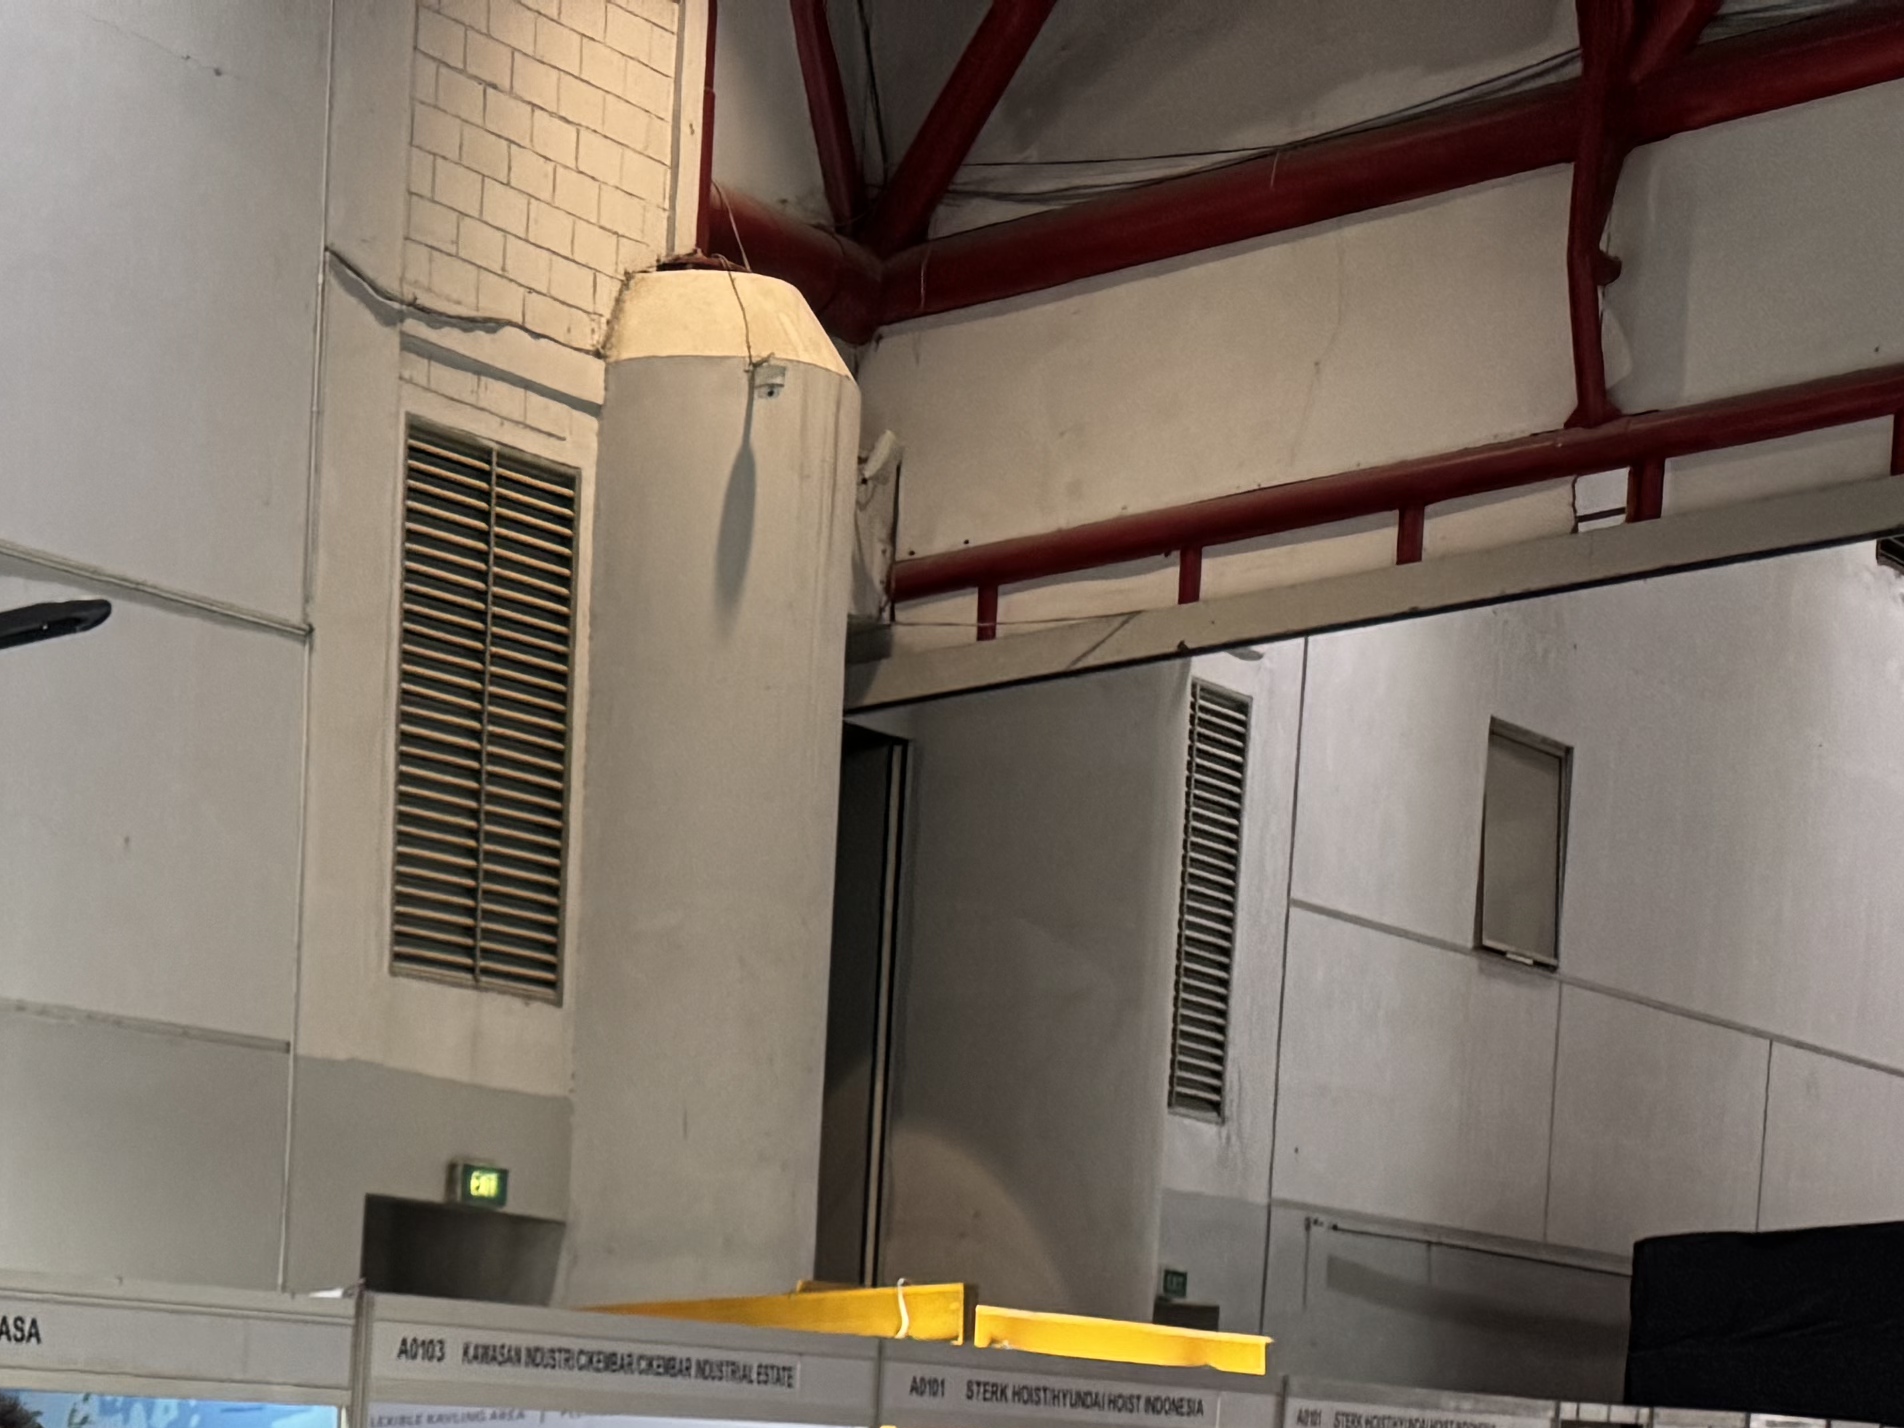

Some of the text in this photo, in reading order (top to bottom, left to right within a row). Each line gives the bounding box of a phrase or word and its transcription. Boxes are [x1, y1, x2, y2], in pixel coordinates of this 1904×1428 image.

[397, 1337, 445, 1362] A0103
[462, 1342, 522, 1366] KAWASAN
[756, 1363, 795, 1389] ESTATE
[909, 1376, 946, 1397] A0101
[965, 1380, 1009, 1402] STERK
[1107, 1393, 1143, 1414] HOIST
[1144, 1396, 1204, 1417] INDONESIA
[371, 1414, 422, 1428] LEXIBLE
